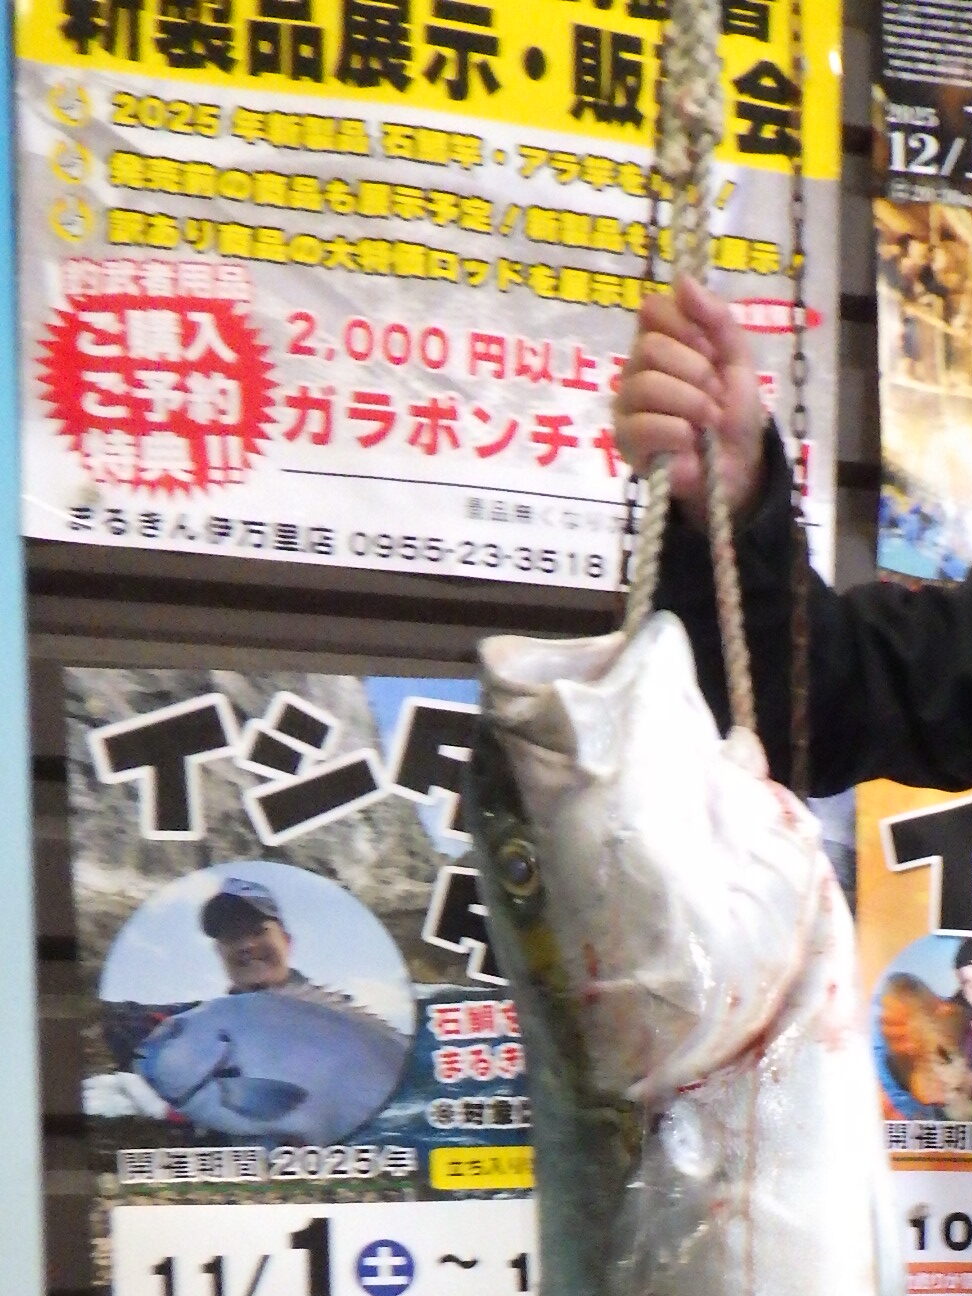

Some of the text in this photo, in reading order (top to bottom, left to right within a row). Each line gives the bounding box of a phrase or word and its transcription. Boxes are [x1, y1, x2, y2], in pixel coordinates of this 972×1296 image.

[60, 0, 802, 156] 新製品展示・販会
[112, 91, 221, 138] 2025
[75, 308, 239, 364] ご購入
[286, 311, 451, 371] 2,000
[80, 370, 243, 427] ご予約
[68, 506, 606, 579] まるきん伊万里店 0955-23-3518
[269, 1145, 419, 1181] 2025年
